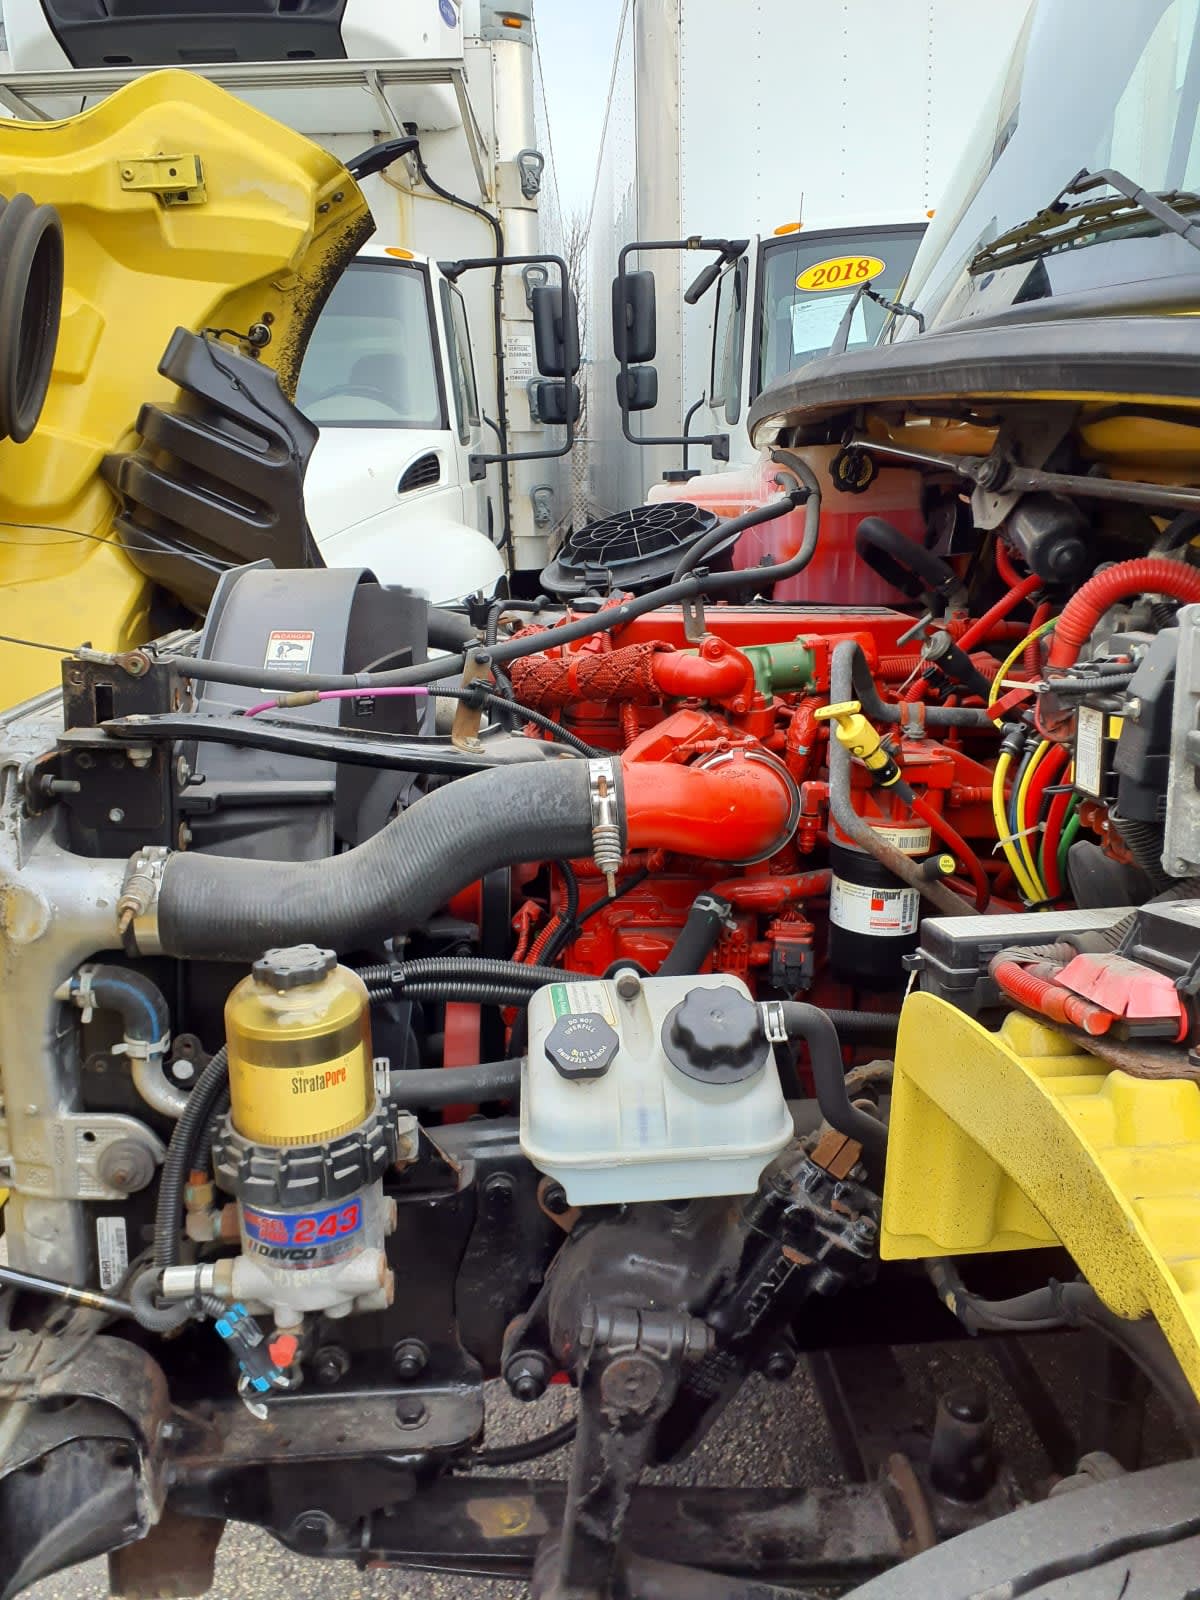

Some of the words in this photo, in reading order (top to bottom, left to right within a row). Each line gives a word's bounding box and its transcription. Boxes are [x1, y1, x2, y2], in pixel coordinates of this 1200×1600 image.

[811, 260, 870, 287] 2018
[564, 1024, 596, 1034] OVERFILL
[557, 1047, 587, 1064] STEERING
[588, 1045, 607, 1062] POWER
[291, 1067, 346, 1094] StrataPore
[293, 1204, 359, 1244] 243
